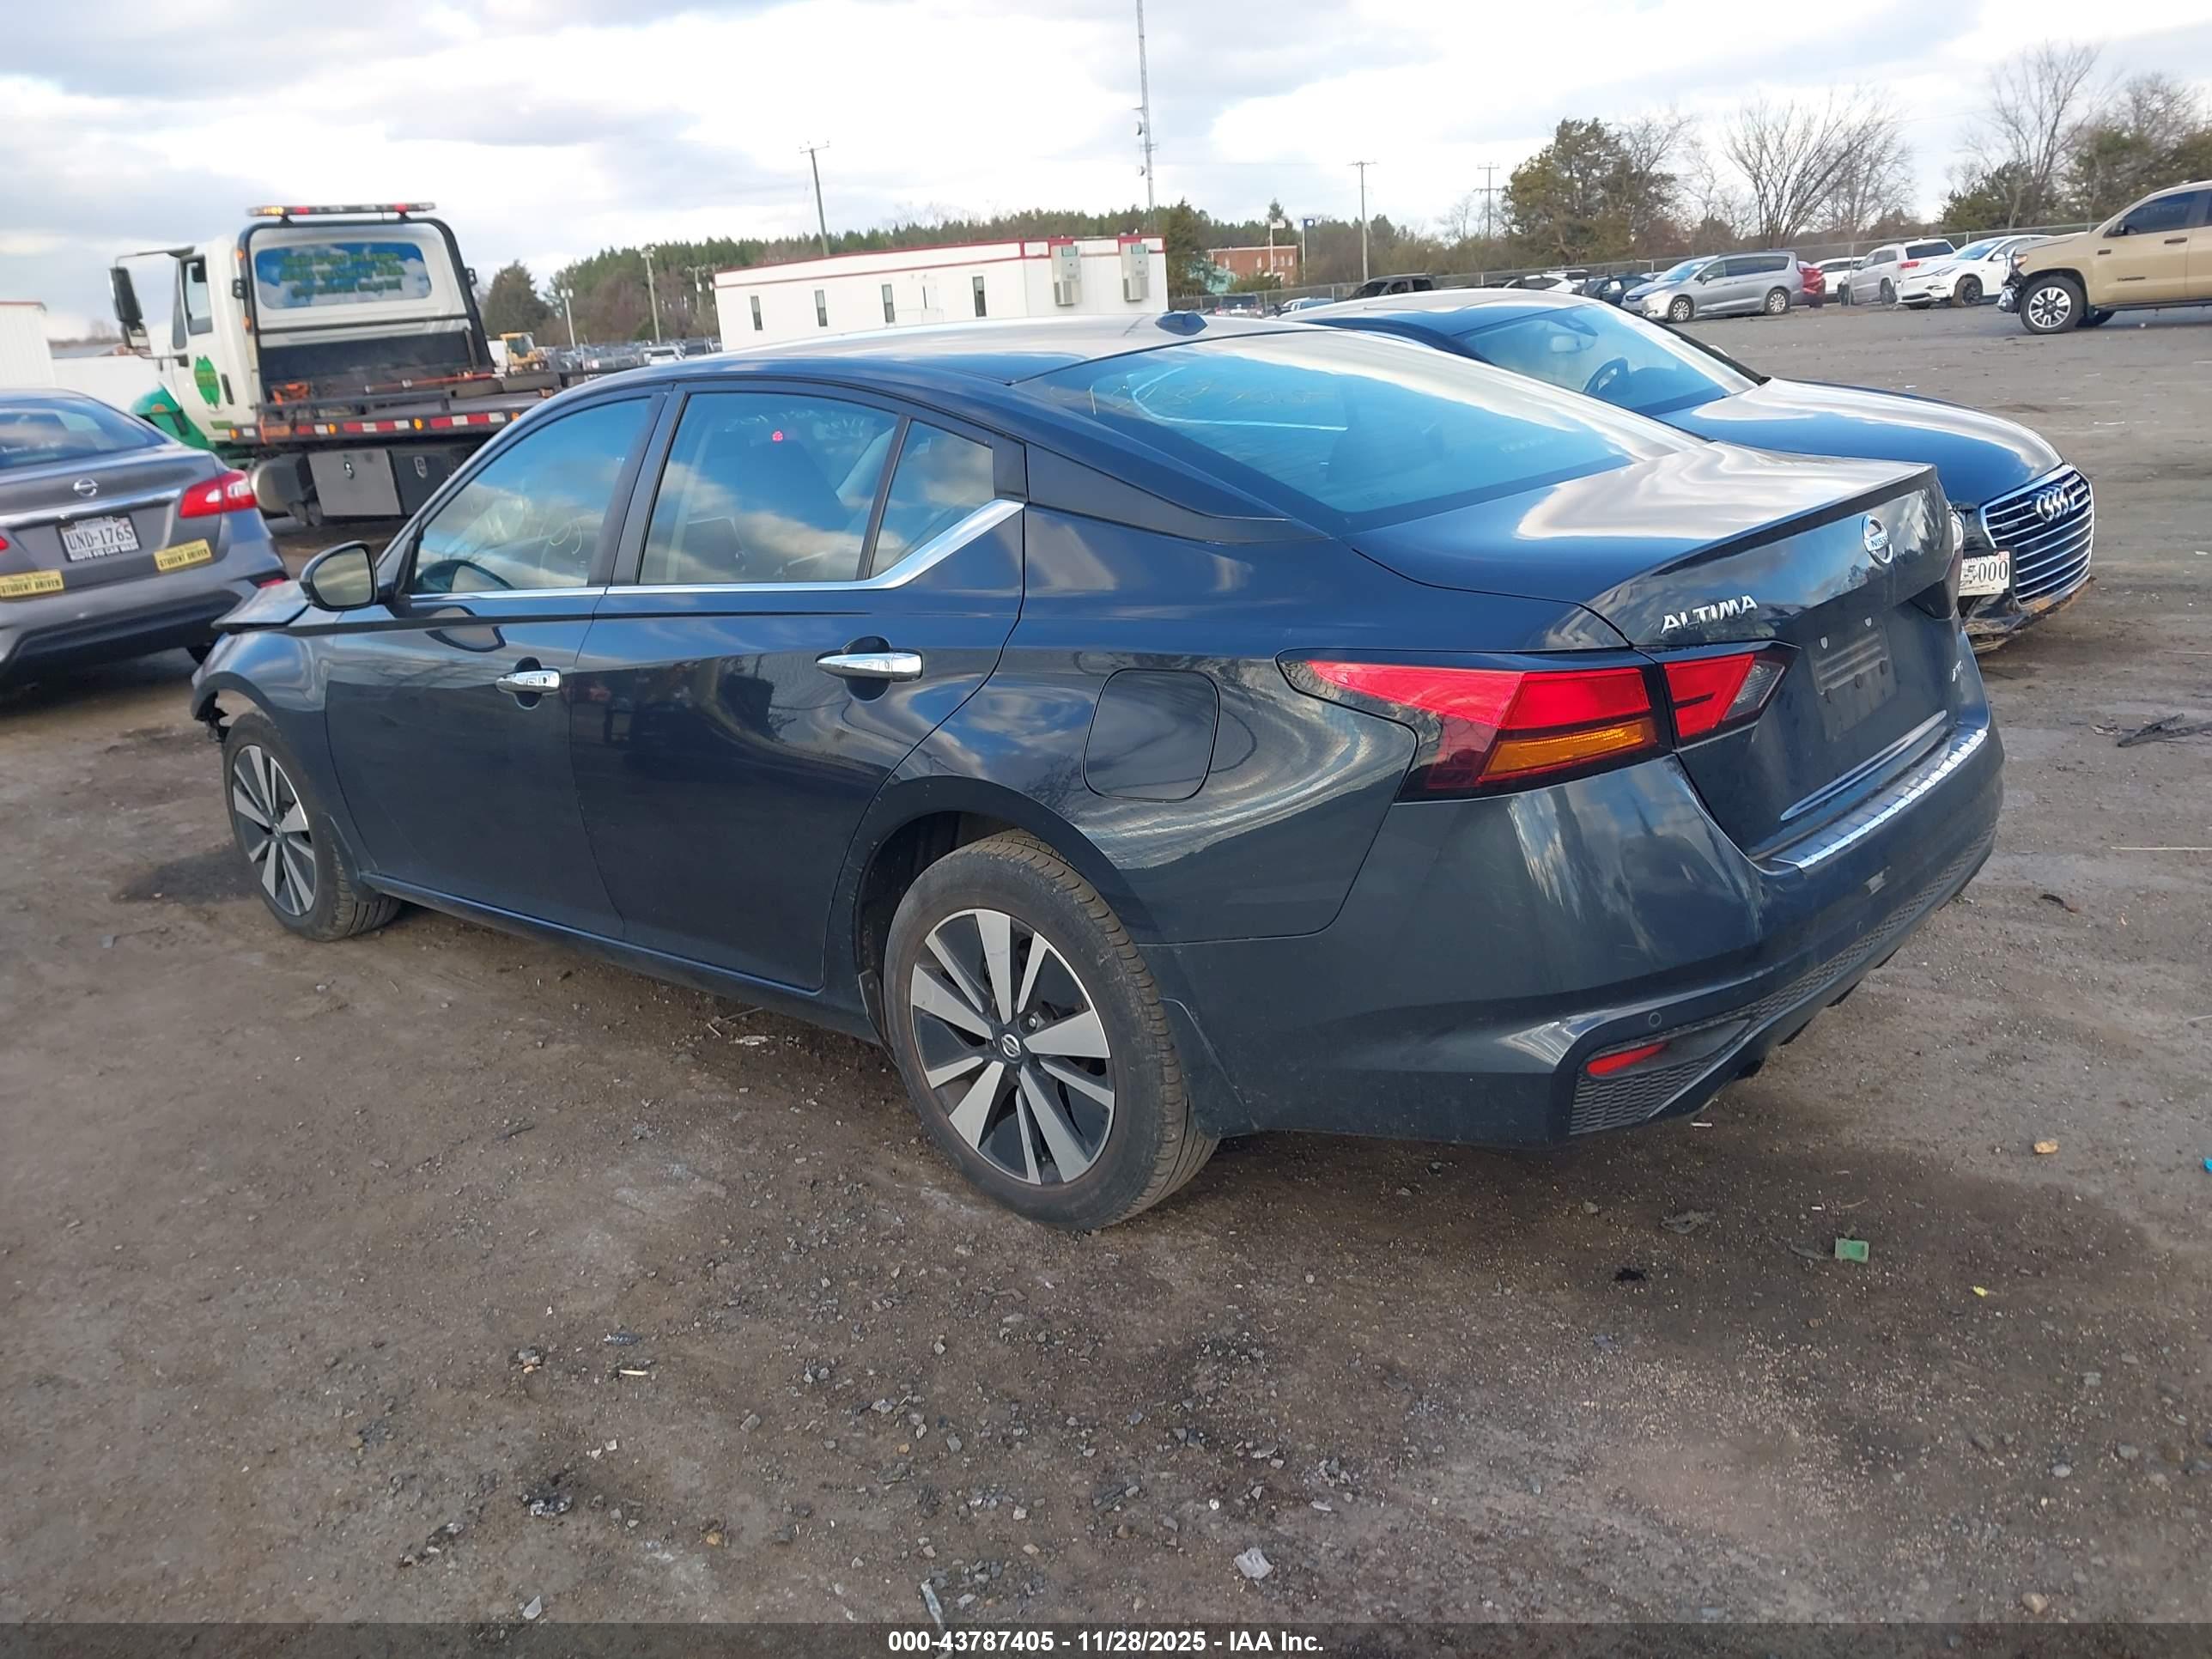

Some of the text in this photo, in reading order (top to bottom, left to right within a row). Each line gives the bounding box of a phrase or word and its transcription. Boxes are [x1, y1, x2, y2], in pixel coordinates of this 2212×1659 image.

[67, 525, 133, 550] UND-1765
[1870, 536, 1889, 548] NISS
[158, 555, 185, 568] STUDENT
[186, 549, 208, 560] DRIVER
[0, 578, 61, 594] STUDENT DRIVER
[1660, 594, 1759, 635] ALTIMA
